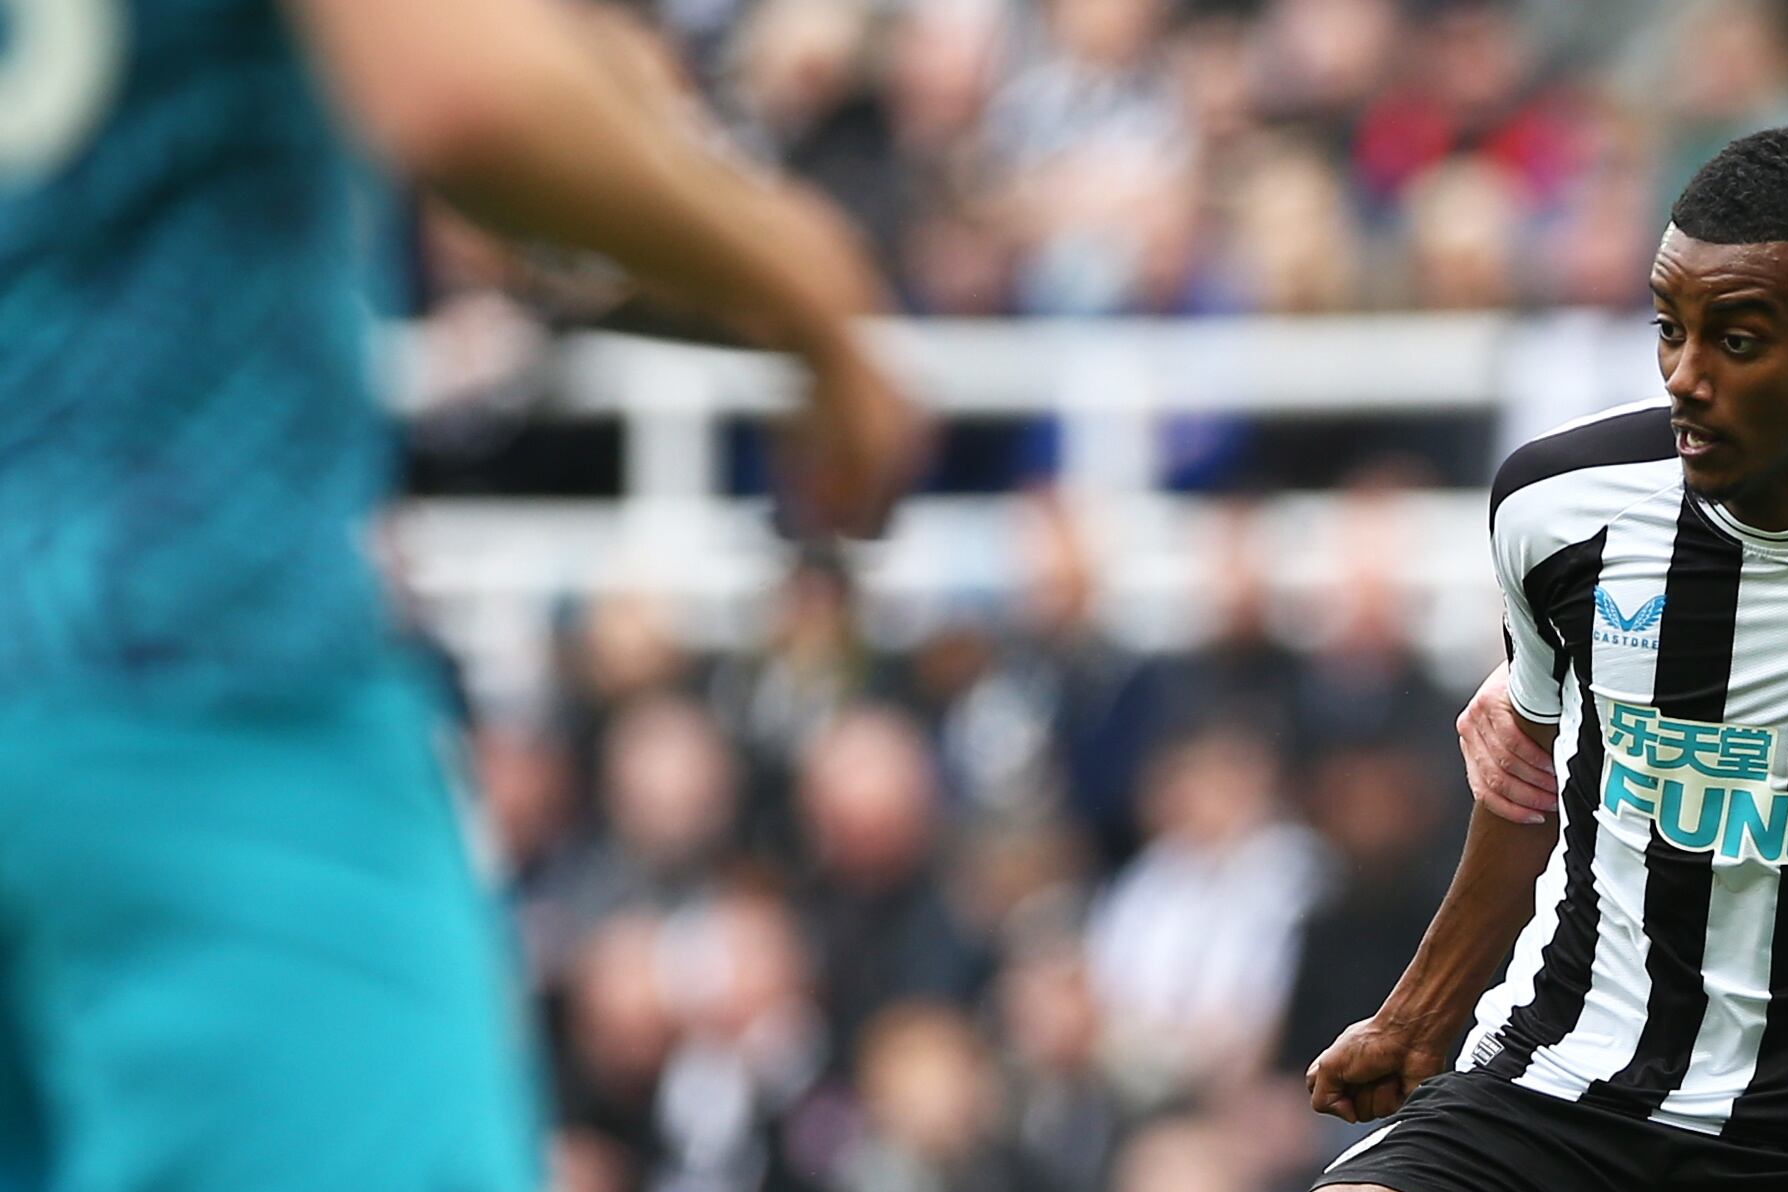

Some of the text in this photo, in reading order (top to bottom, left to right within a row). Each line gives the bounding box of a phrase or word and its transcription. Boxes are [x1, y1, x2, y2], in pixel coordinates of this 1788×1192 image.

[1593, 630, 1658, 650] CASTORE
[1608, 703, 1772, 782] 乐天堂
